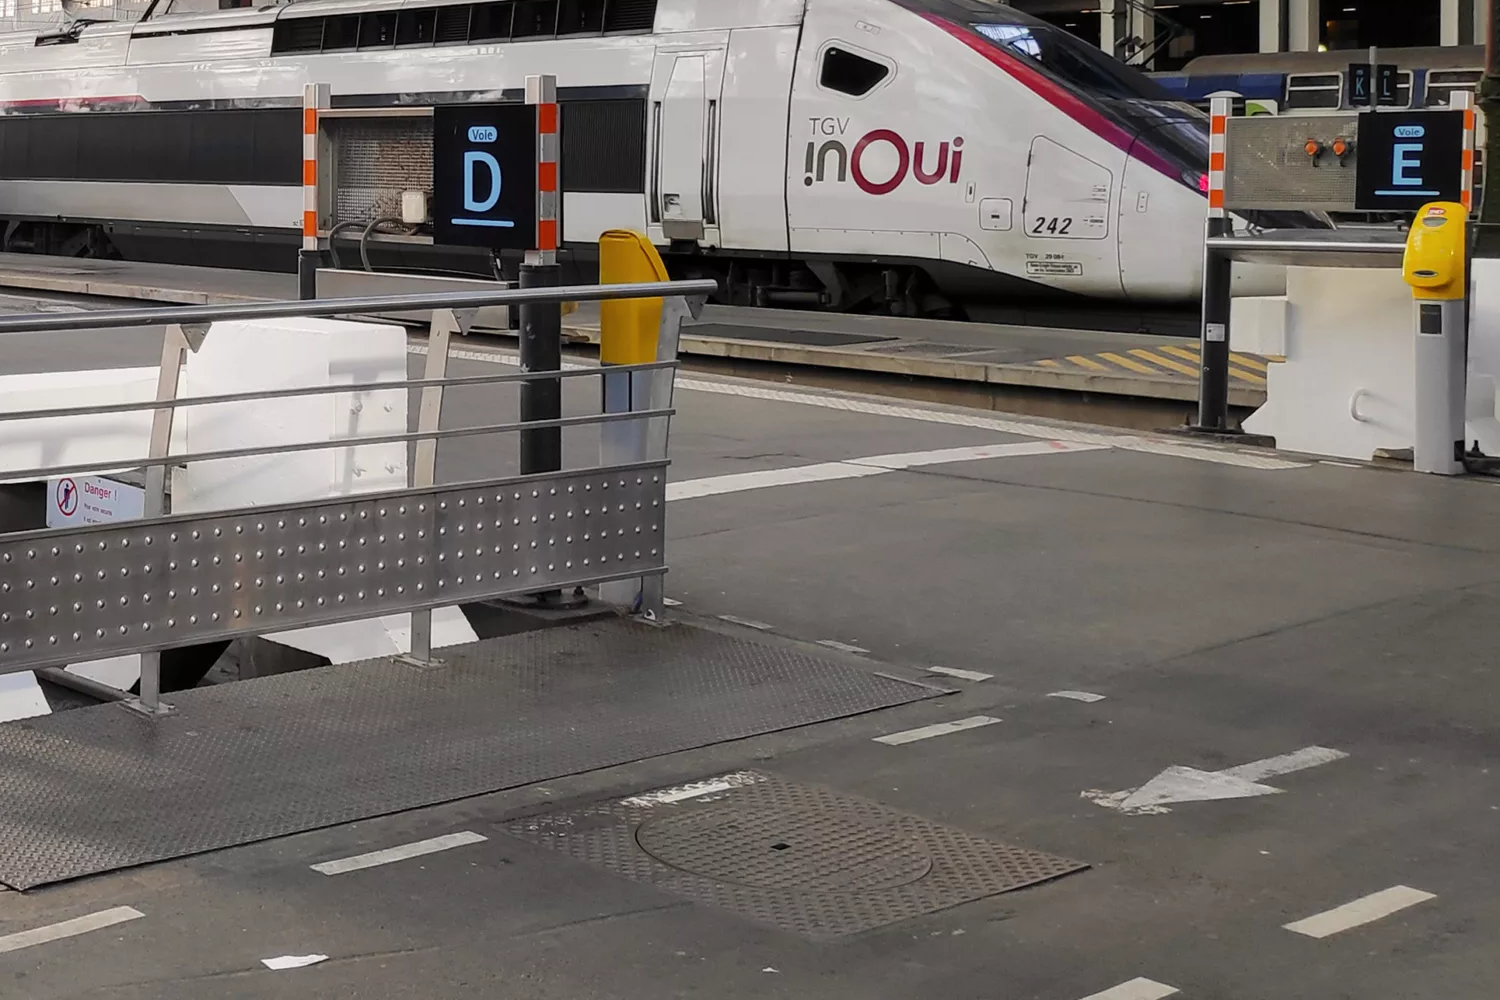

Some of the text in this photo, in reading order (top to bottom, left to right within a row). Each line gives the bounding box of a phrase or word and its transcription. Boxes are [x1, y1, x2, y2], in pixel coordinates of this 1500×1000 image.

[1355, 78, 1365, 96] K
[1383, 78, 1391, 96] L
[471, 129, 493, 142] Voie
[809, 117, 850, 136] TGV
[1398, 127, 1420, 137] Voie
[1392, 143, 1424, 186] E
[463, 151, 502, 213] D
[1031, 216, 1073, 235] 242
[84, 481, 112, 500] Danger
